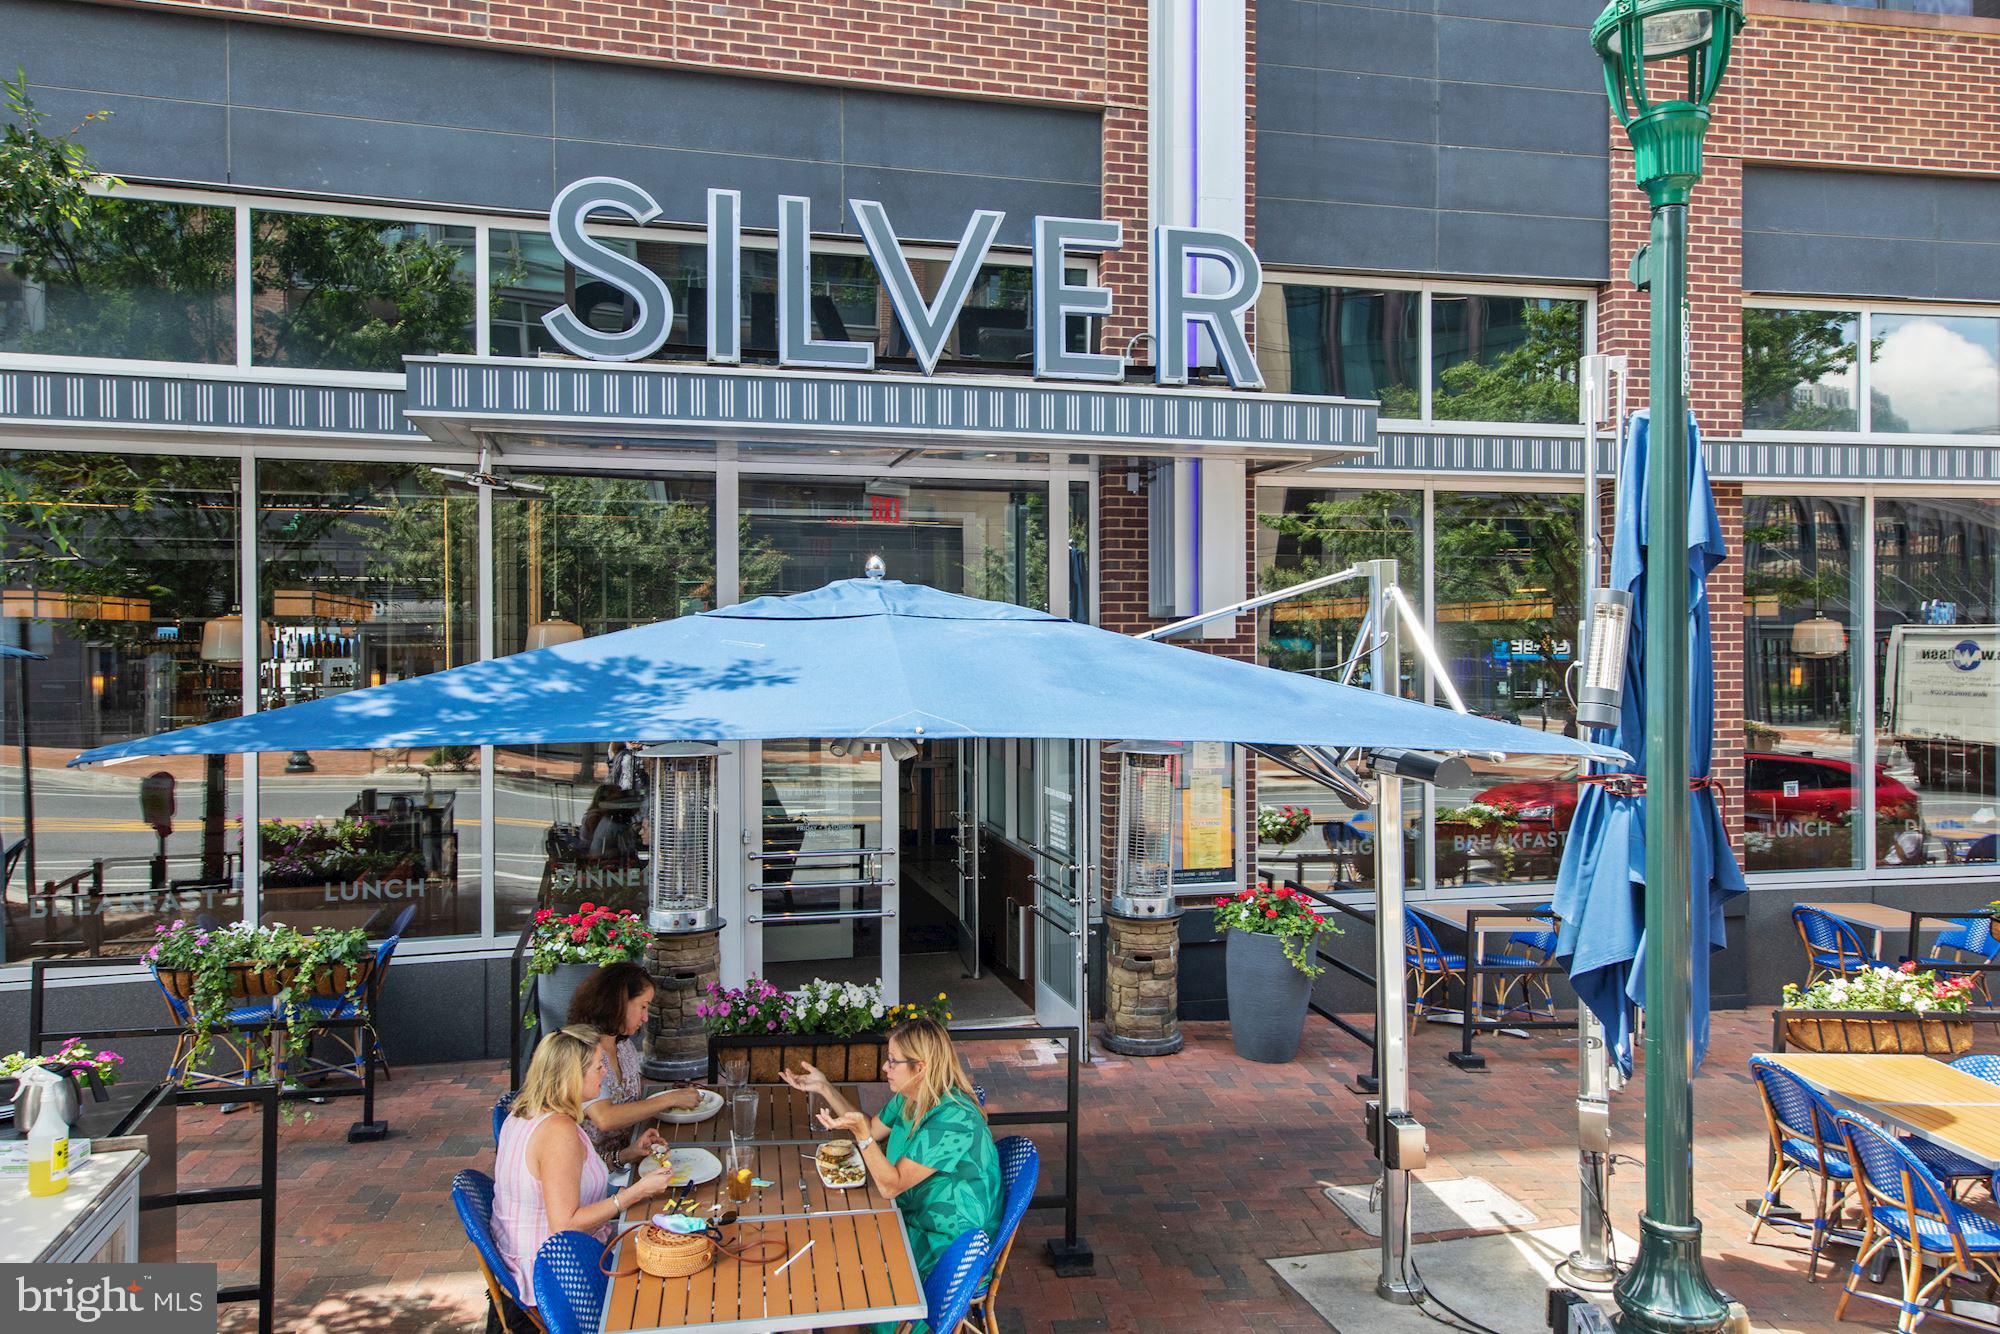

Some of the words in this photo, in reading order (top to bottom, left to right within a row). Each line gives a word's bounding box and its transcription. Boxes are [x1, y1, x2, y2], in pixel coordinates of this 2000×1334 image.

[541, 176, 1266, 390] SILVER
[1453, 830, 1569, 852] BREAKFAST
[1766, 821, 1831, 839] LUNCH
[325, 877, 425, 902] LUNCH
